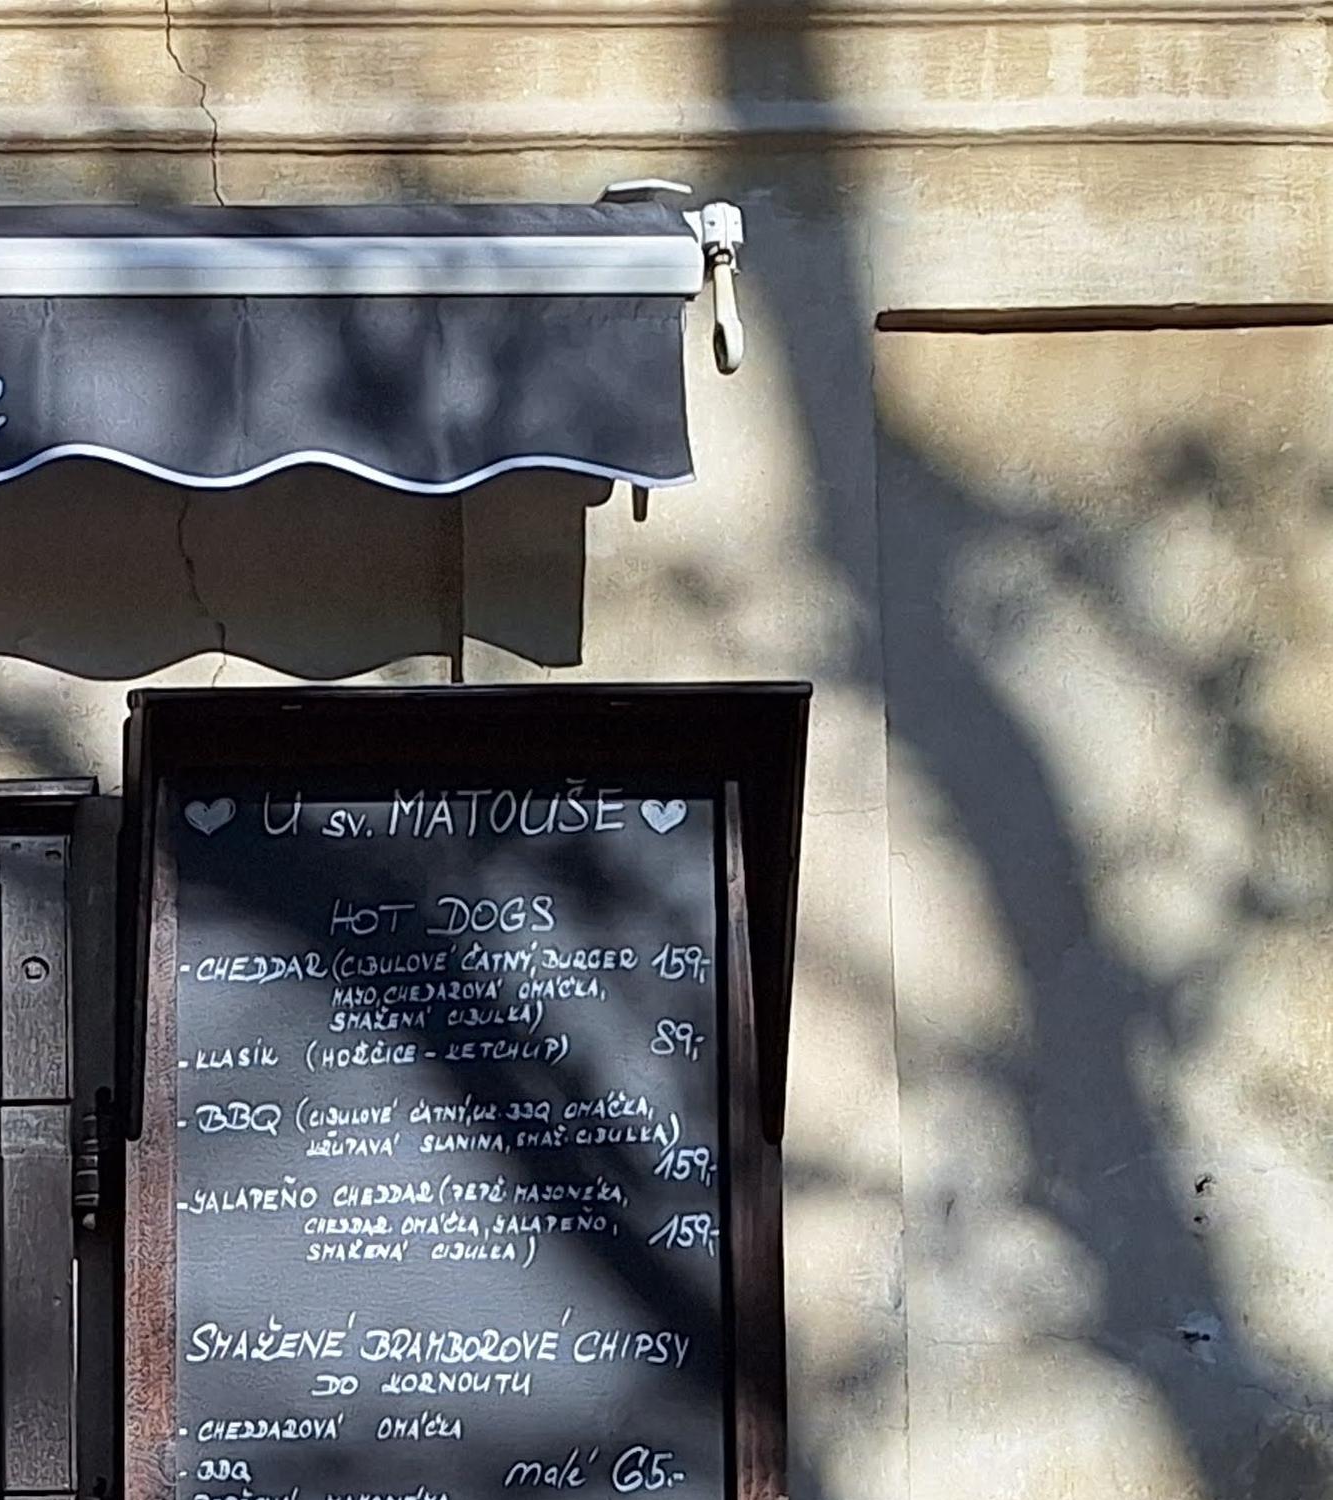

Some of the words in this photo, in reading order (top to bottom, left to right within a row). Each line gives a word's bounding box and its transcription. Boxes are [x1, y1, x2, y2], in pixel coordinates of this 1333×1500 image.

[263, 791, 302, 835] U
[386, 777, 625, 838] MATOUŠE
[330, 899, 415, 935] HOT
[427, 895, 555, 935] DOGS
[185, 1311, 356, 1362] SMAŽENÉ
[360, 1307, 571, 1364] BRAMBOROVÉ
[573, 1330, 689, 1368] CHIPSY
[311, 1374, 359, 1396] DO
[381, 1371, 531, 1396] KORNOUTU
[504, 1448, 598, 1489] malé
